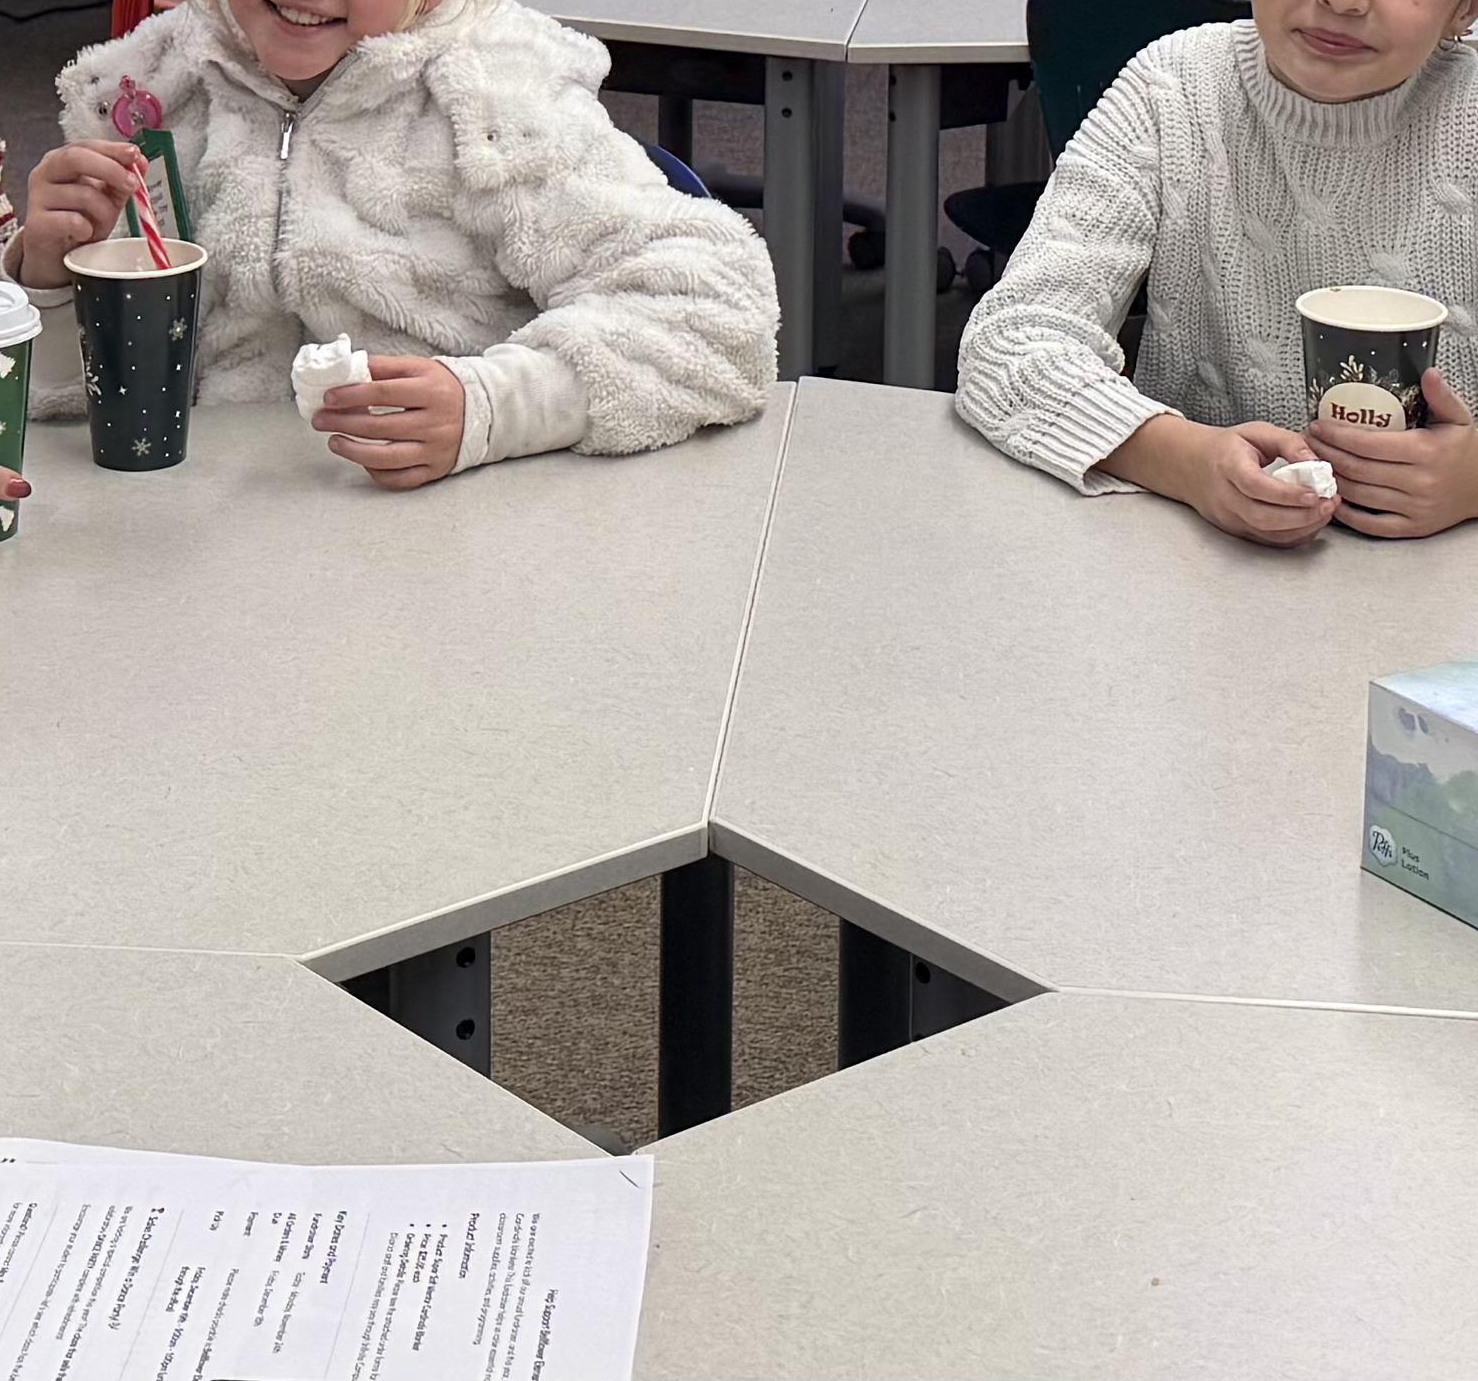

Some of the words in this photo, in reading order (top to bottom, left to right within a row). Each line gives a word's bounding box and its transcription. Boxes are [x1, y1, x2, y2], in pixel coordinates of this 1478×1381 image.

[1330, 402, 1392, 428] Holly
[335, 1211, 347, 1223] Key
[331, 1225, 345, 1243] Dates
[466, 1213, 480, 1240] Product
[327, 1245, 337, 1257] and
